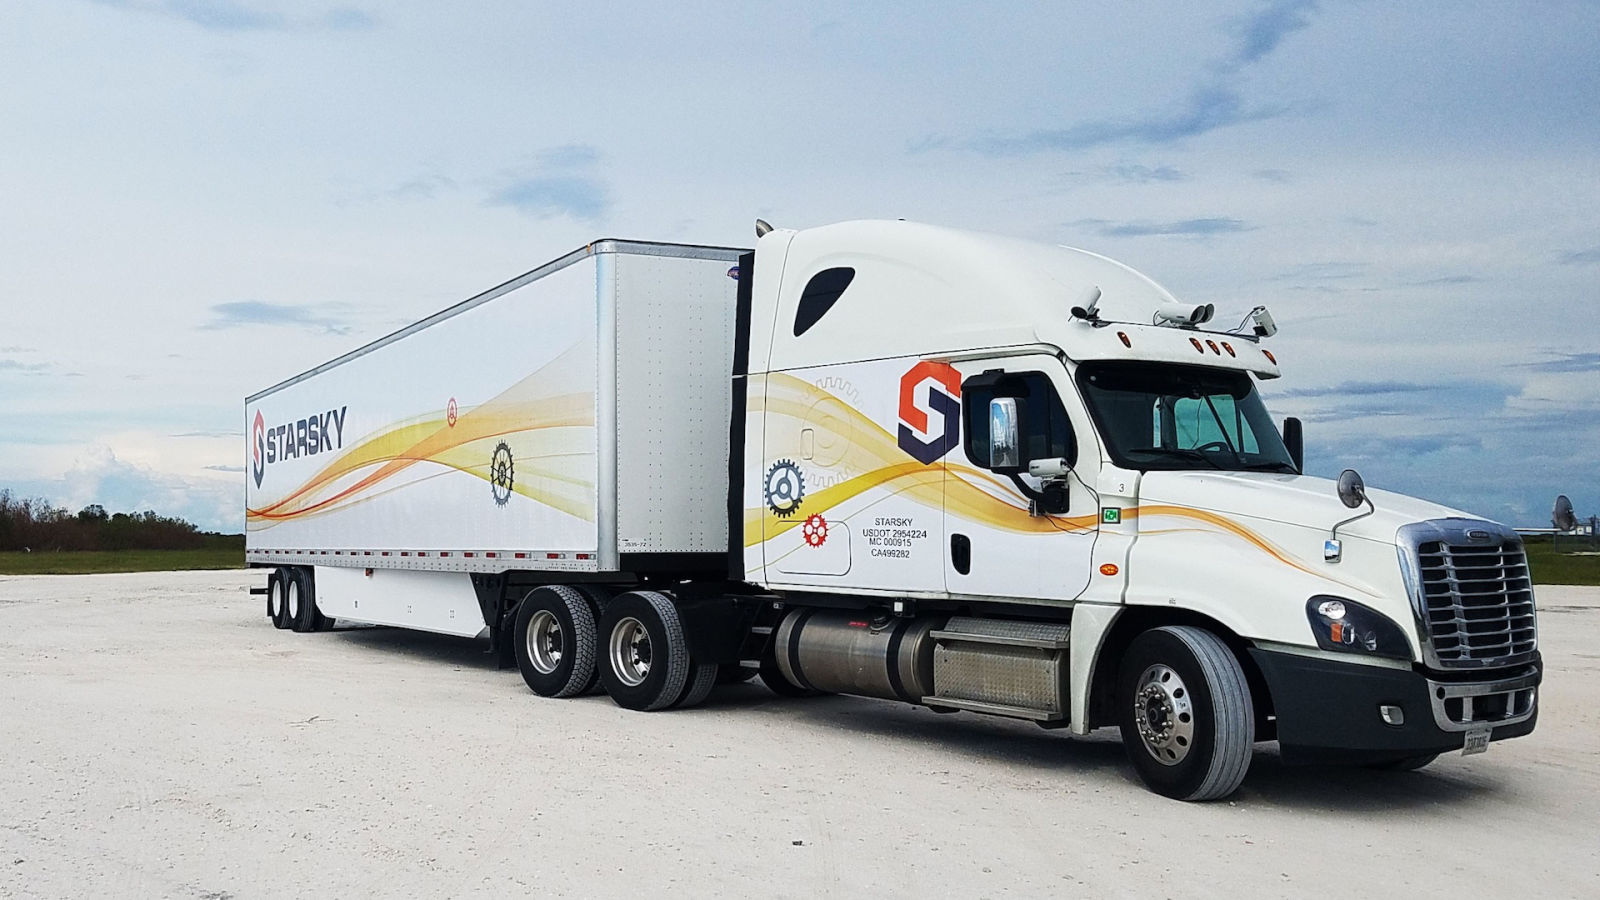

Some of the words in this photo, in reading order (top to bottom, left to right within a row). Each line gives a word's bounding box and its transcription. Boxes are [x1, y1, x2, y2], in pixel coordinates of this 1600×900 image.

[267, 406, 347, 463] STARSKY
[1119, 484, 1125, 492] 3
[875, 518, 913, 526] STARSKY
[863, 529, 891, 537] USDOT
[892, 530, 927, 538] 2954224
[883, 538, 912, 546] 000915
[871, 549, 910, 558] CA499282
